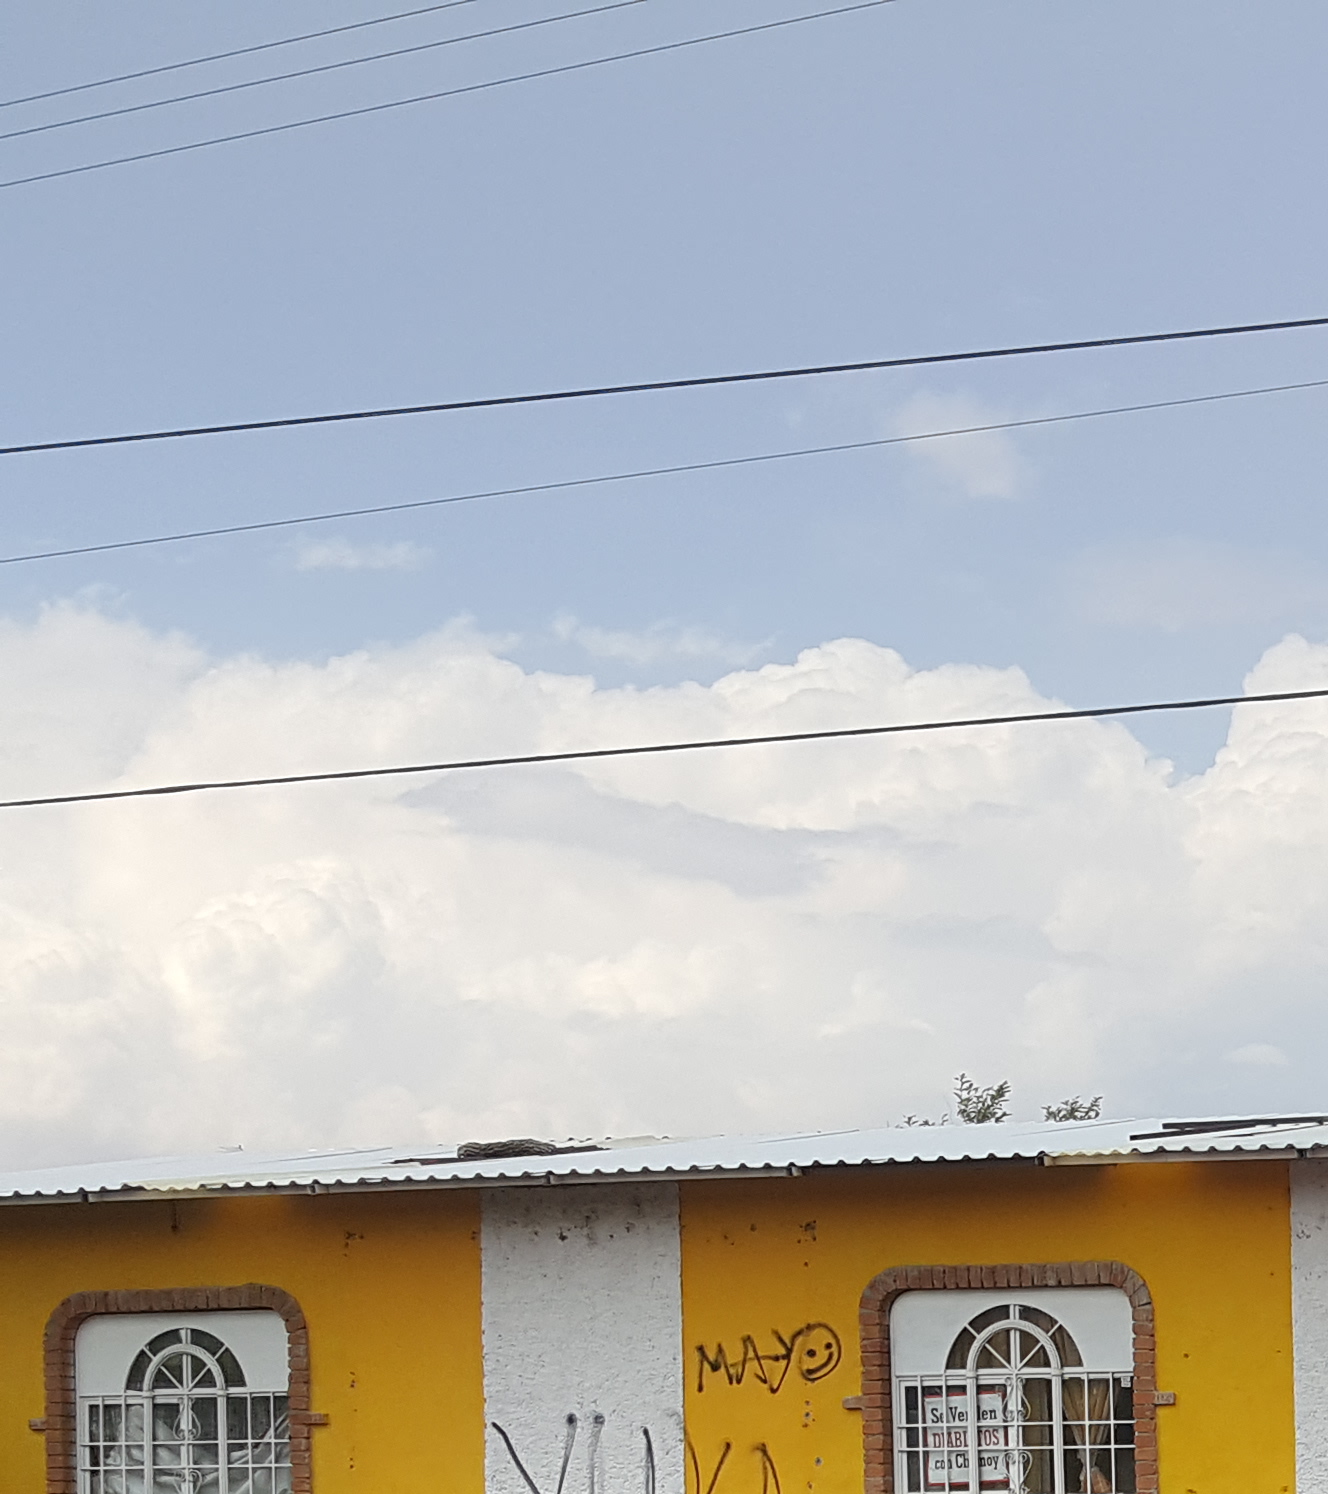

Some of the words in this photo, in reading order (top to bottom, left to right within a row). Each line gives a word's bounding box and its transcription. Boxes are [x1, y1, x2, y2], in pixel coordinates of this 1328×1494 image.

[949, 1405, 997, 1422] Veen
[932, 1428, 999, 1448] DIABLTOS
[956, 1453, 999, 1470] Chmoy
